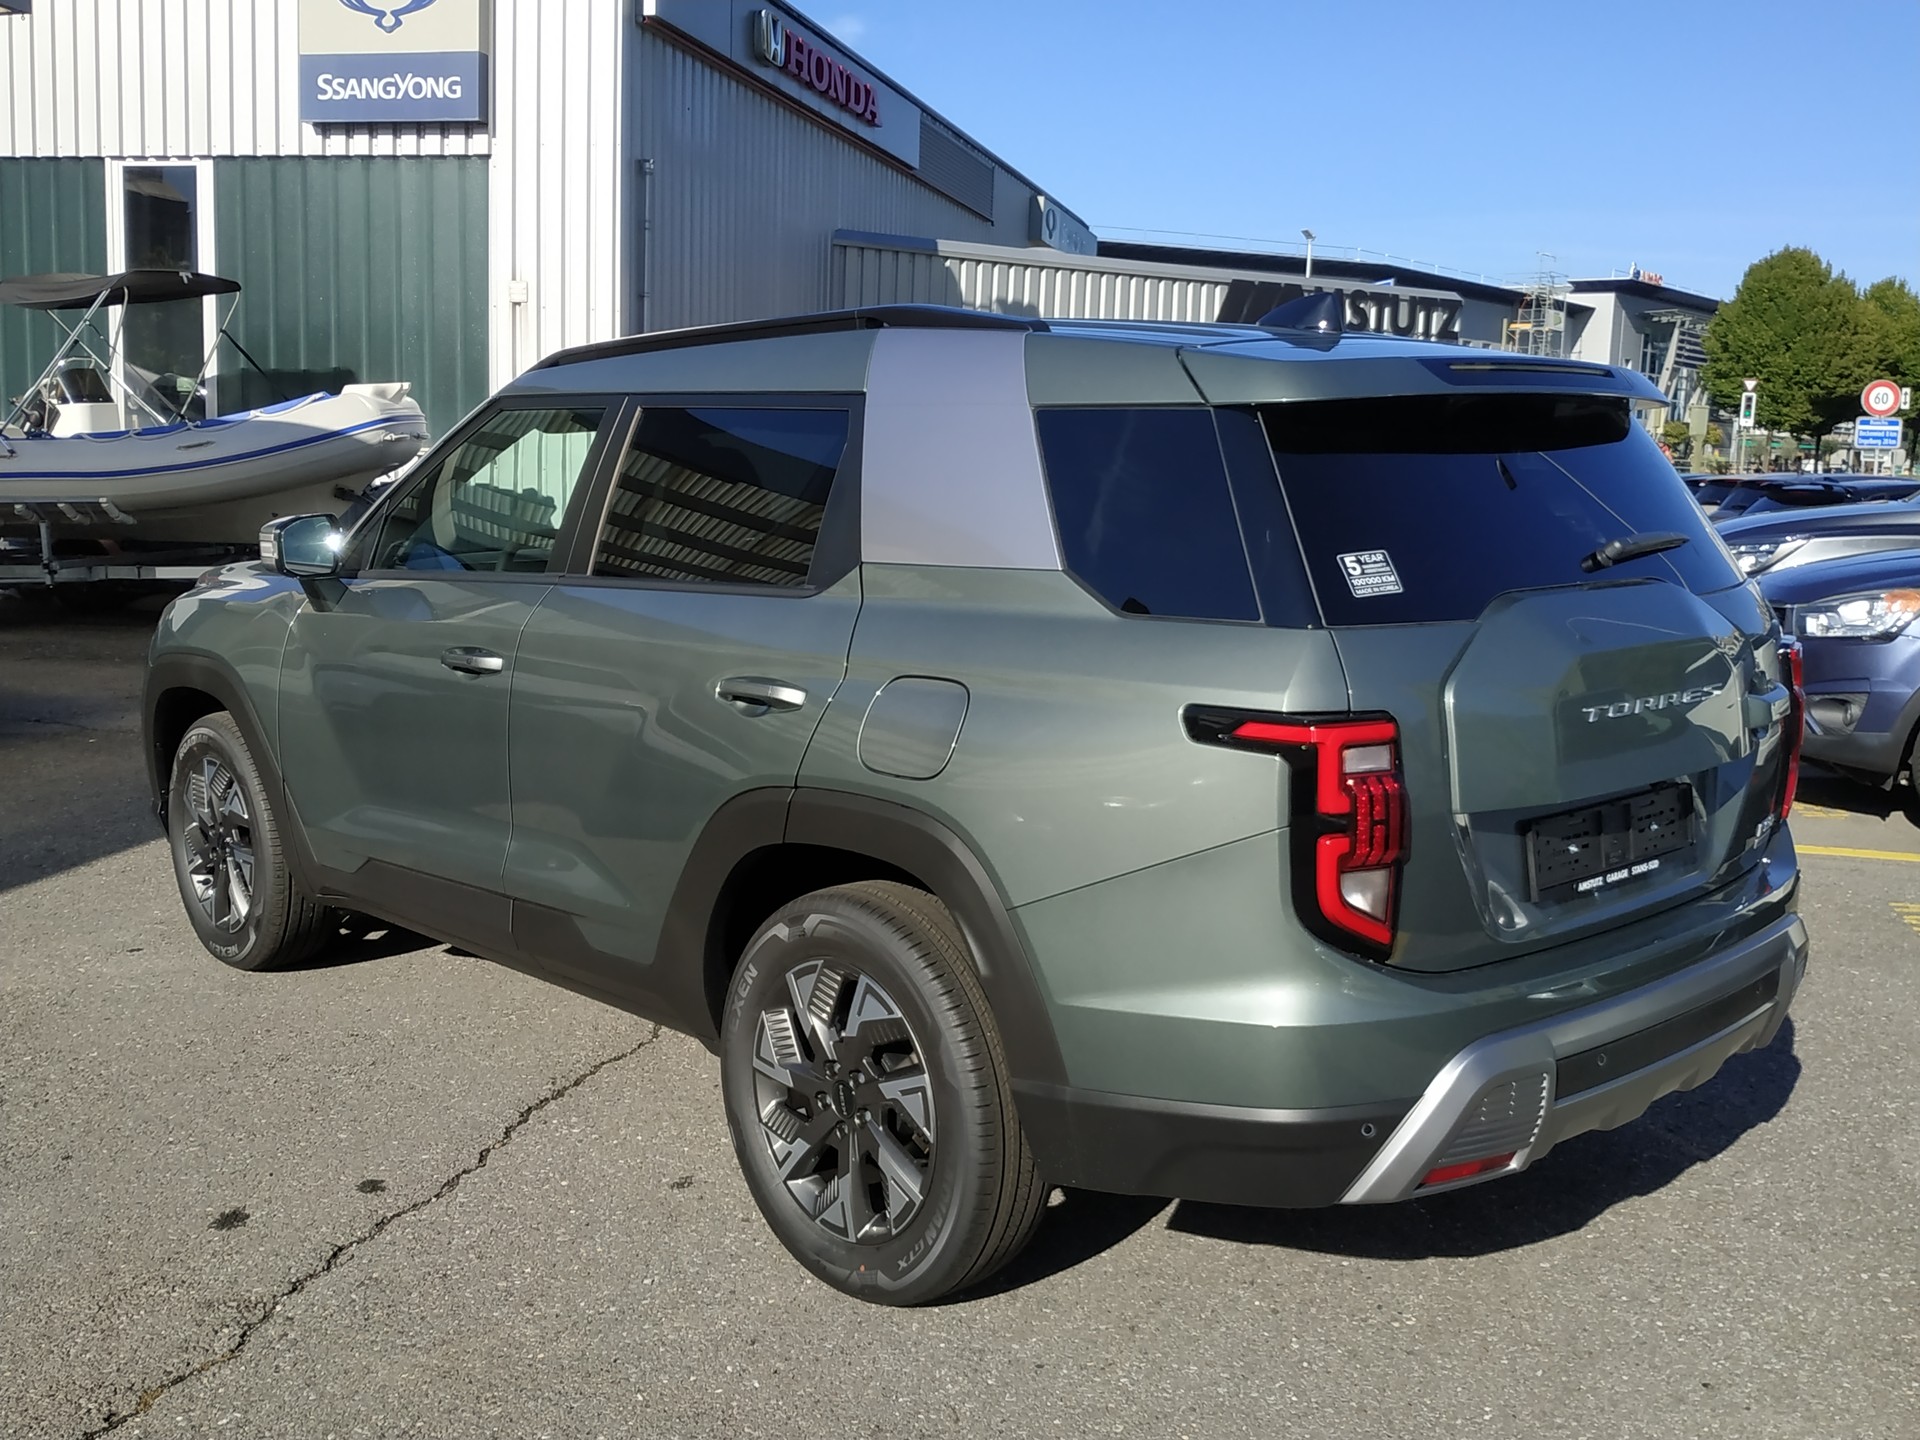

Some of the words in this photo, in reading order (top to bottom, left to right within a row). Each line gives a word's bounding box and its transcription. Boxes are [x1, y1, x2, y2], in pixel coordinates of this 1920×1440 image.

[784, 29, 883, 128] HONDA
[1873, 392, 1889, 405] 60
[1343, 555, 1362, 576] 5
[1357, 553, 1385, 564] YEAR
[1581, 682, 1723, 723] TORRES
[1606, 868, 1629, 883] GARAGE
